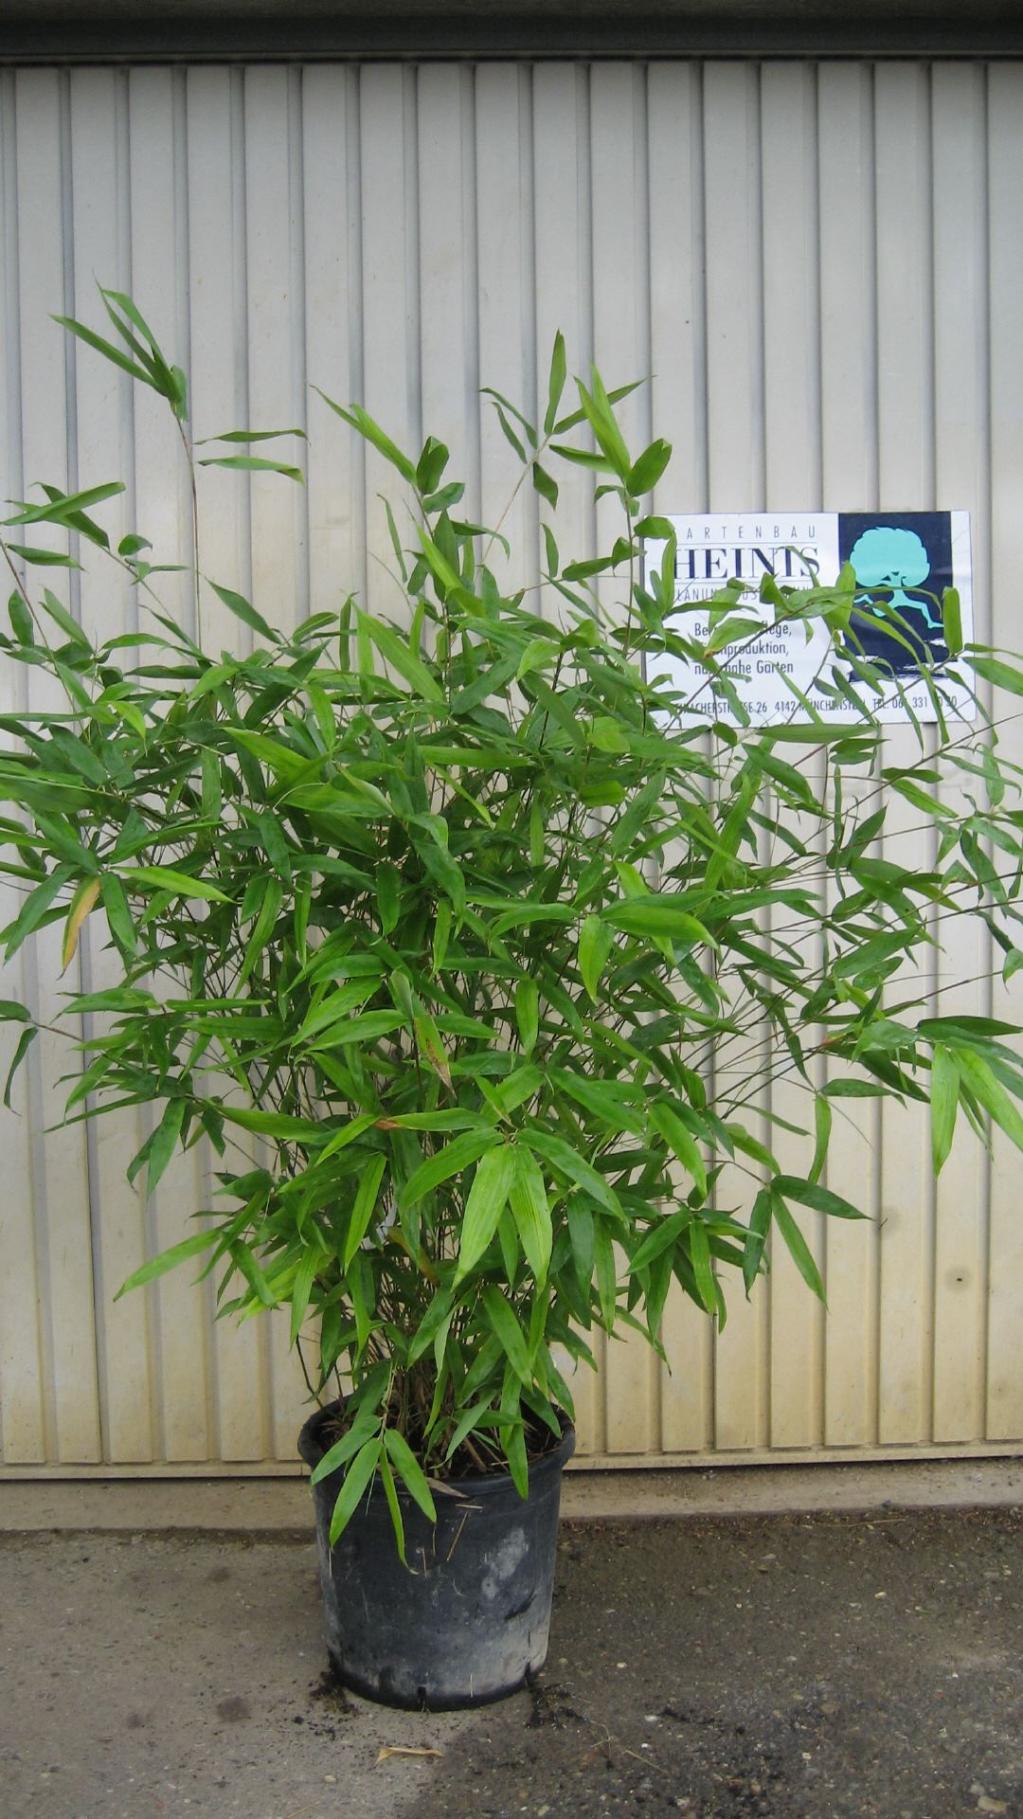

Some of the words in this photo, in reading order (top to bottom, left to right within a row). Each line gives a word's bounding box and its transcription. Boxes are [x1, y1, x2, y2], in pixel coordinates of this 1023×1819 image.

[686, 525, 816, 540] ARTENBAU
[673, 546, 820, 579] HEINIS
[774, 700, 796, 712] 4142
[912, 696, 927, 708] 331
